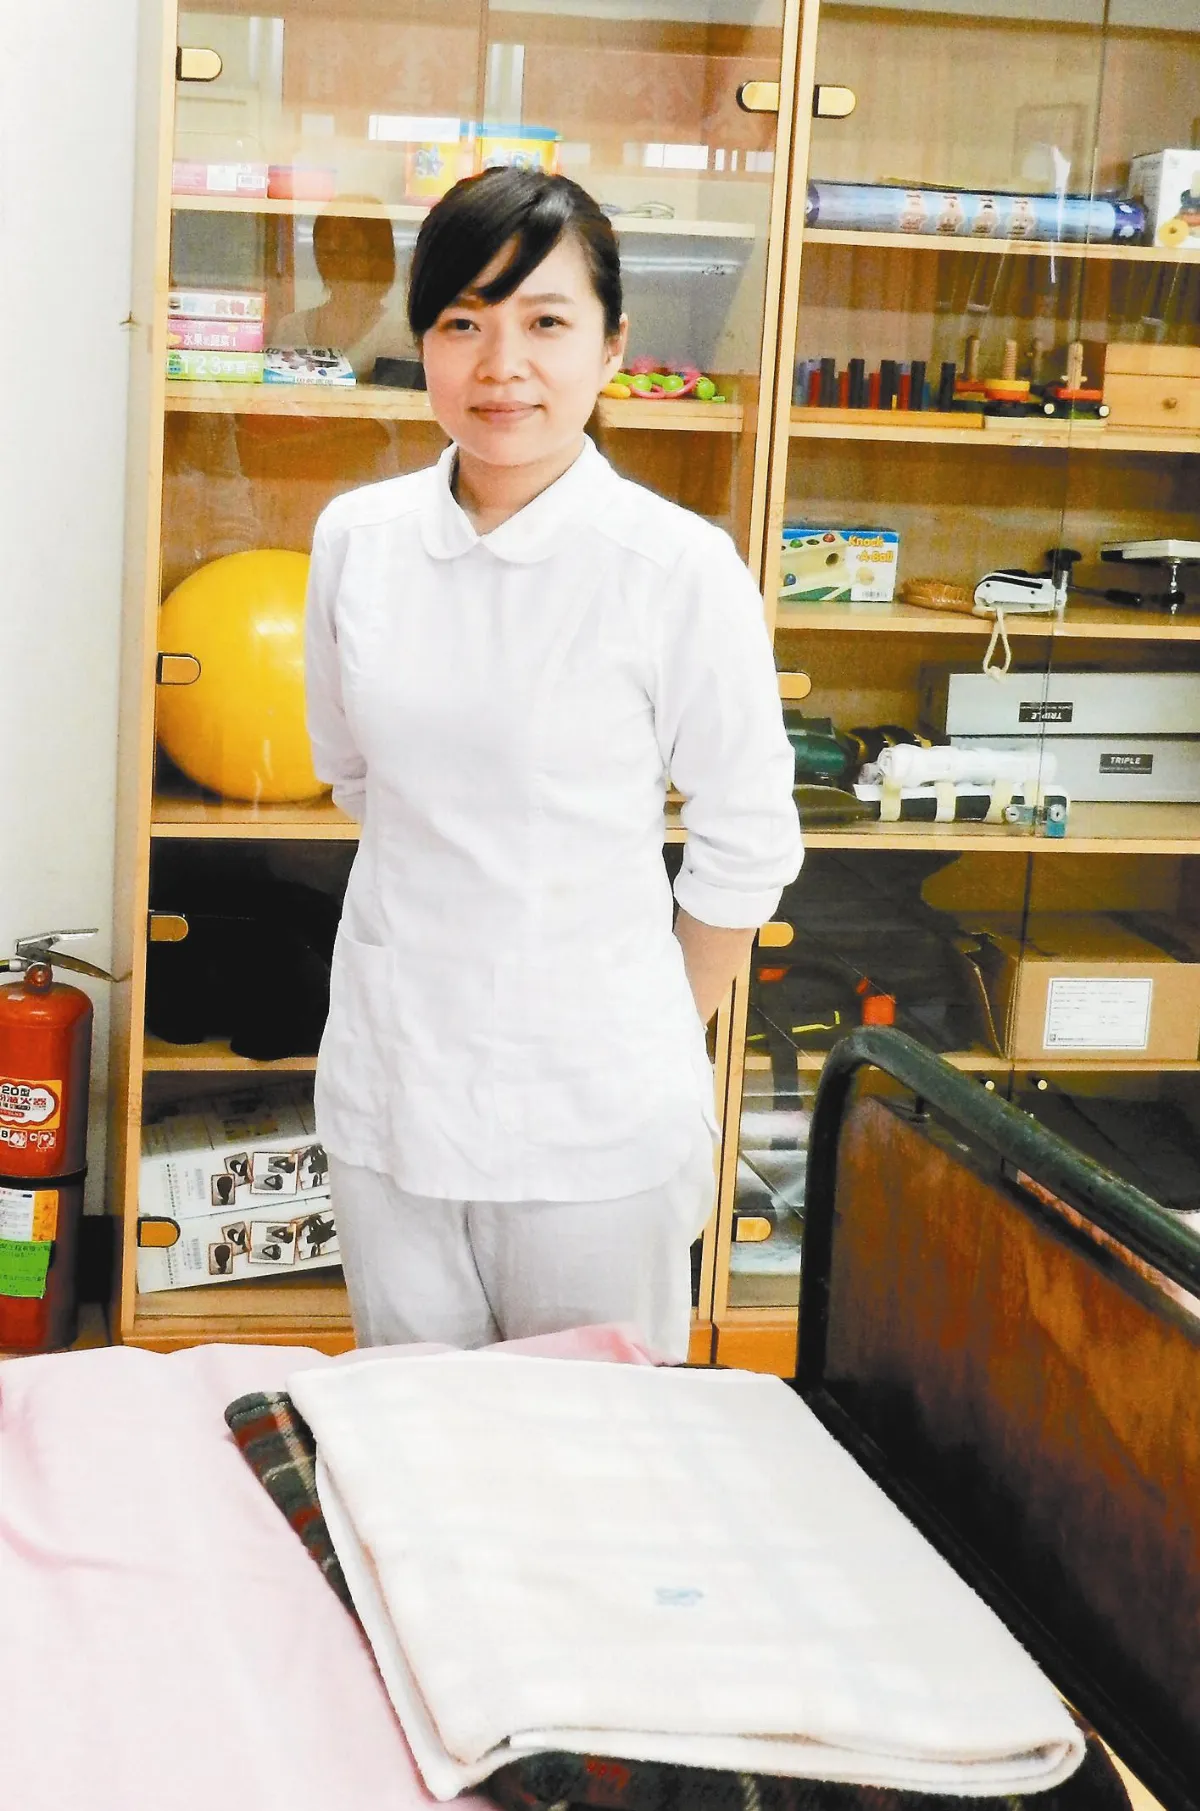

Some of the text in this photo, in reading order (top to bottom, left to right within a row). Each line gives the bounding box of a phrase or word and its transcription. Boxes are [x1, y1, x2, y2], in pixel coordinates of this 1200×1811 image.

[848, 535, 884, 547] Knock
[1031, 712, 1062, 720] TRIPLE
[1110, 756, 1141, 765] TRIPLE
[2, 1130, 8, 1138] B
